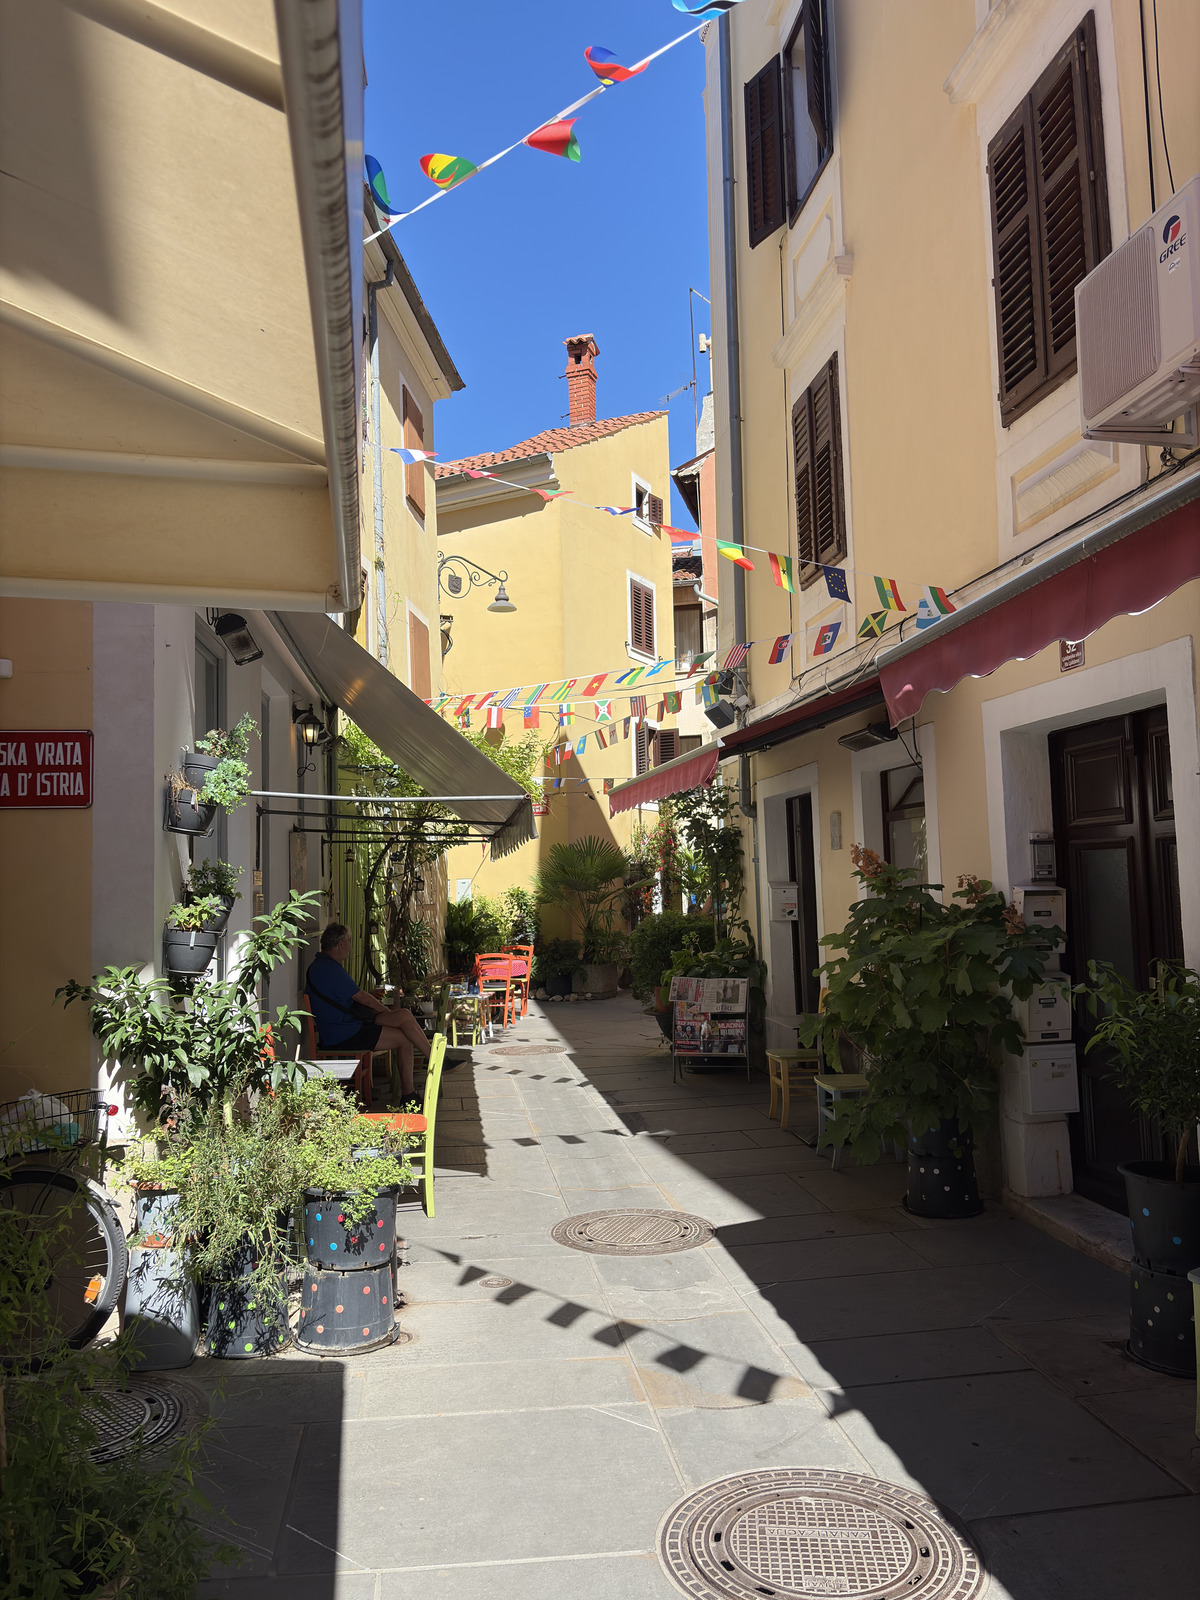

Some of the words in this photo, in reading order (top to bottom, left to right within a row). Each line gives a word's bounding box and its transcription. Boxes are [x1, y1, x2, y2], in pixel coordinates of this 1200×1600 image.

[1160, 233, 1186, 264] GREE
[35, 742, 83, 766] VRATA
[0, 773, 11, 797] A
[768, 1528, 870, 1538] KANALIZACIJA
